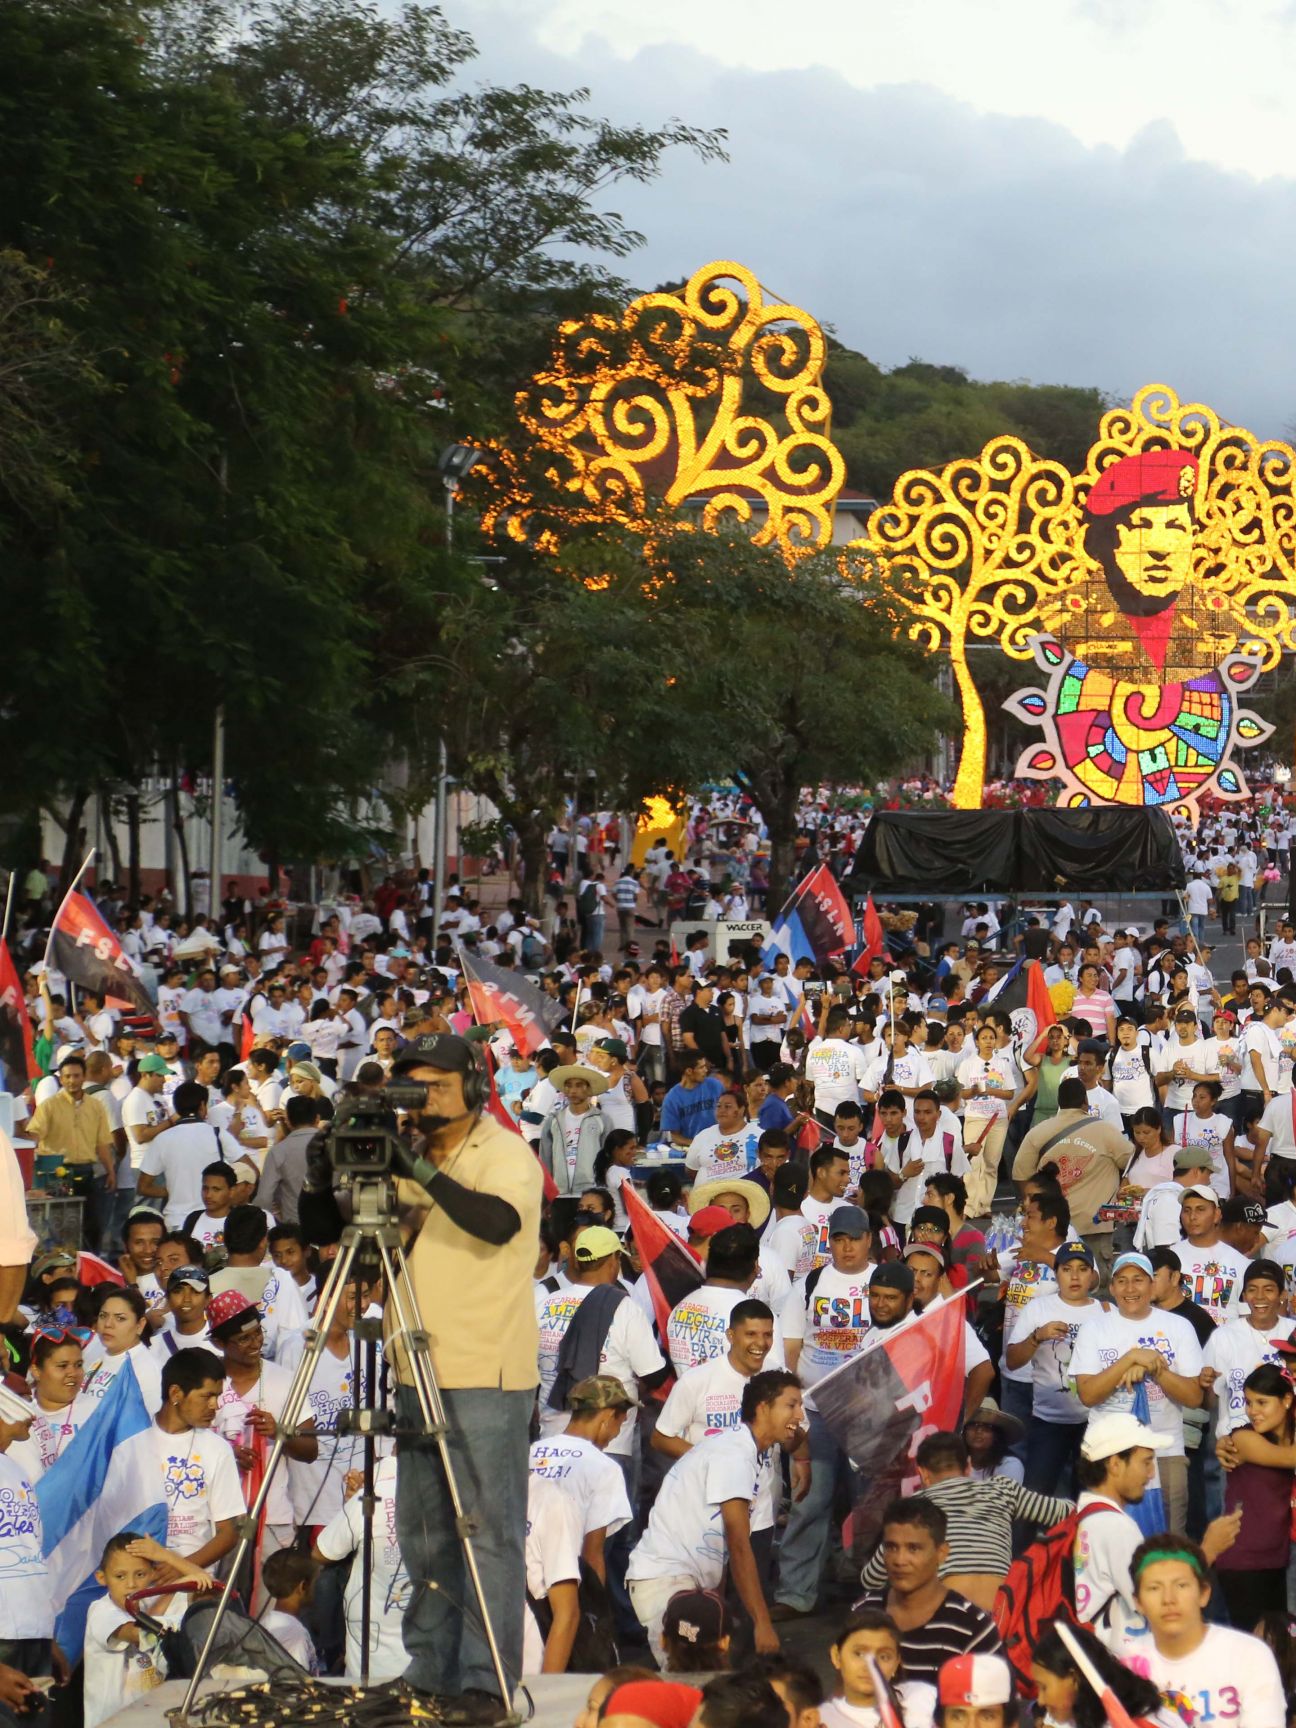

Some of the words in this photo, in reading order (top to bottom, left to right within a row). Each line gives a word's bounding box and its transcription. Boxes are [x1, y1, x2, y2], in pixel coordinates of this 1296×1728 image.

[726, 923, 762, 932] WACKER
[76, 928, 141, 978] FSL
[540, 1304, 580, 1320] ALE
[706, 1412, 738, 1429] FSLN
[533, 1447, 583, 1459] HAGO
